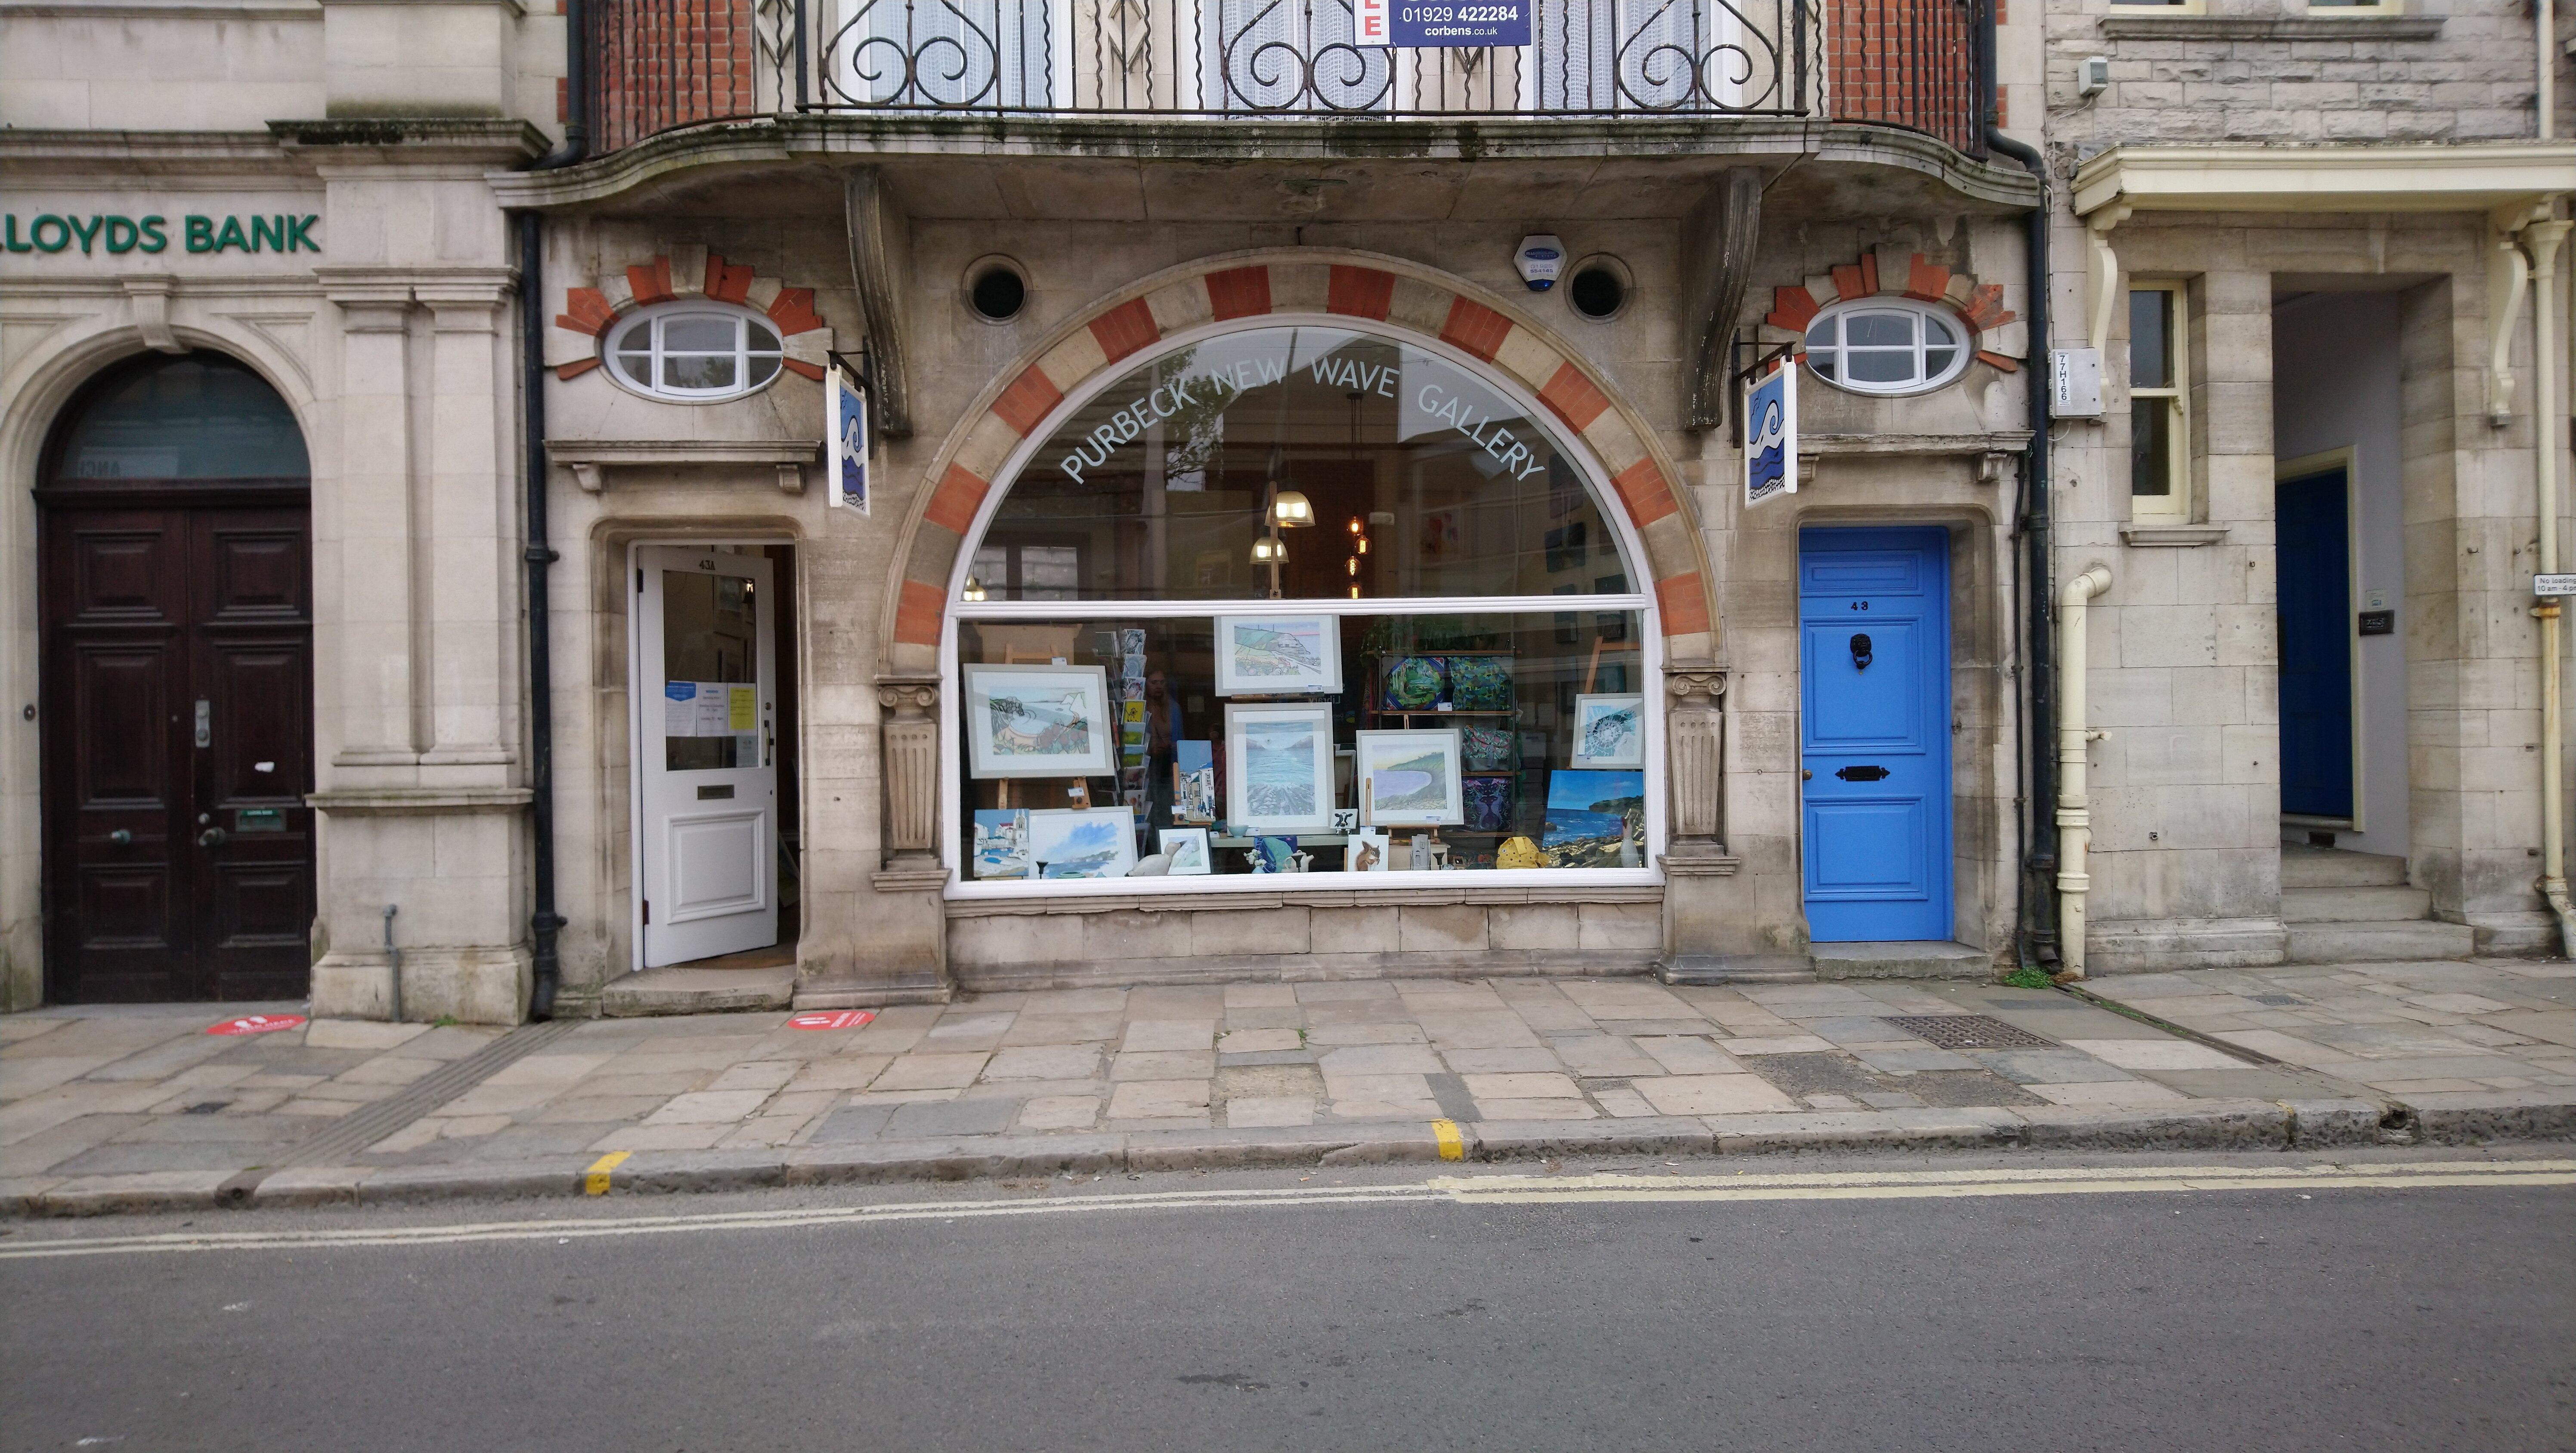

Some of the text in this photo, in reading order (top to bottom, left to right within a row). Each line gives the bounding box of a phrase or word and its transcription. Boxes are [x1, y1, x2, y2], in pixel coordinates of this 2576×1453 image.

[1403, 6, 1518, 22] 01929 422284
[1425, 25, 1498, 36] corbens.co.uk
[0, 214, 321, 253] LOYDS BANK
[1060, 356, 1546, 485] PURBECK NEW WAVE GALLERY
[699, 560, 715, 570] 43A
[1851, 601, 1868, 611] 43
